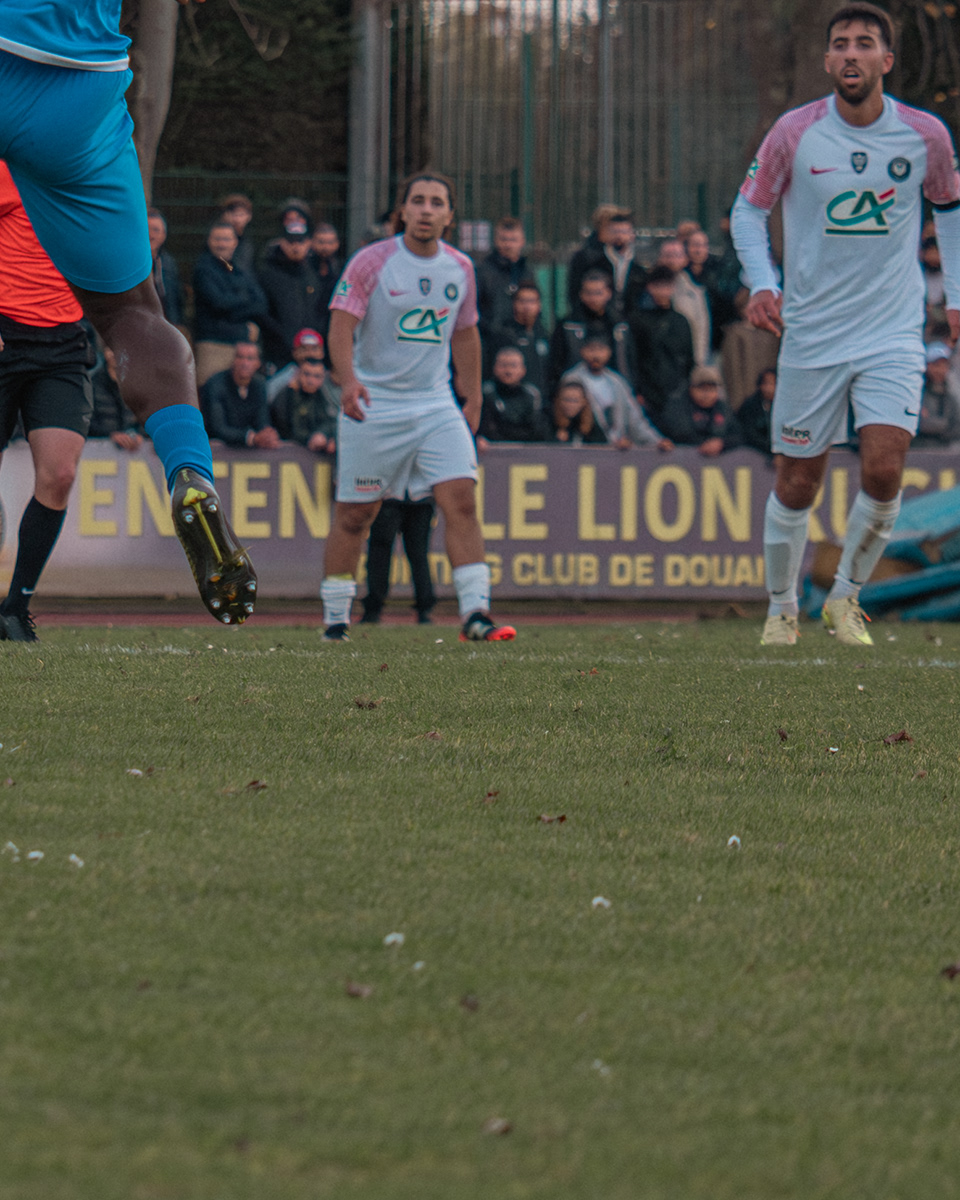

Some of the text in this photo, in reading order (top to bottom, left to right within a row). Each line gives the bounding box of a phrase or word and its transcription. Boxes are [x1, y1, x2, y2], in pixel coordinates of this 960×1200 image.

[476, 464, 548, 540] LE
[578, 464, 752, 542] LION
[512, 553, 600, 586] CLUB
[609, 554, 654, 586] DE
